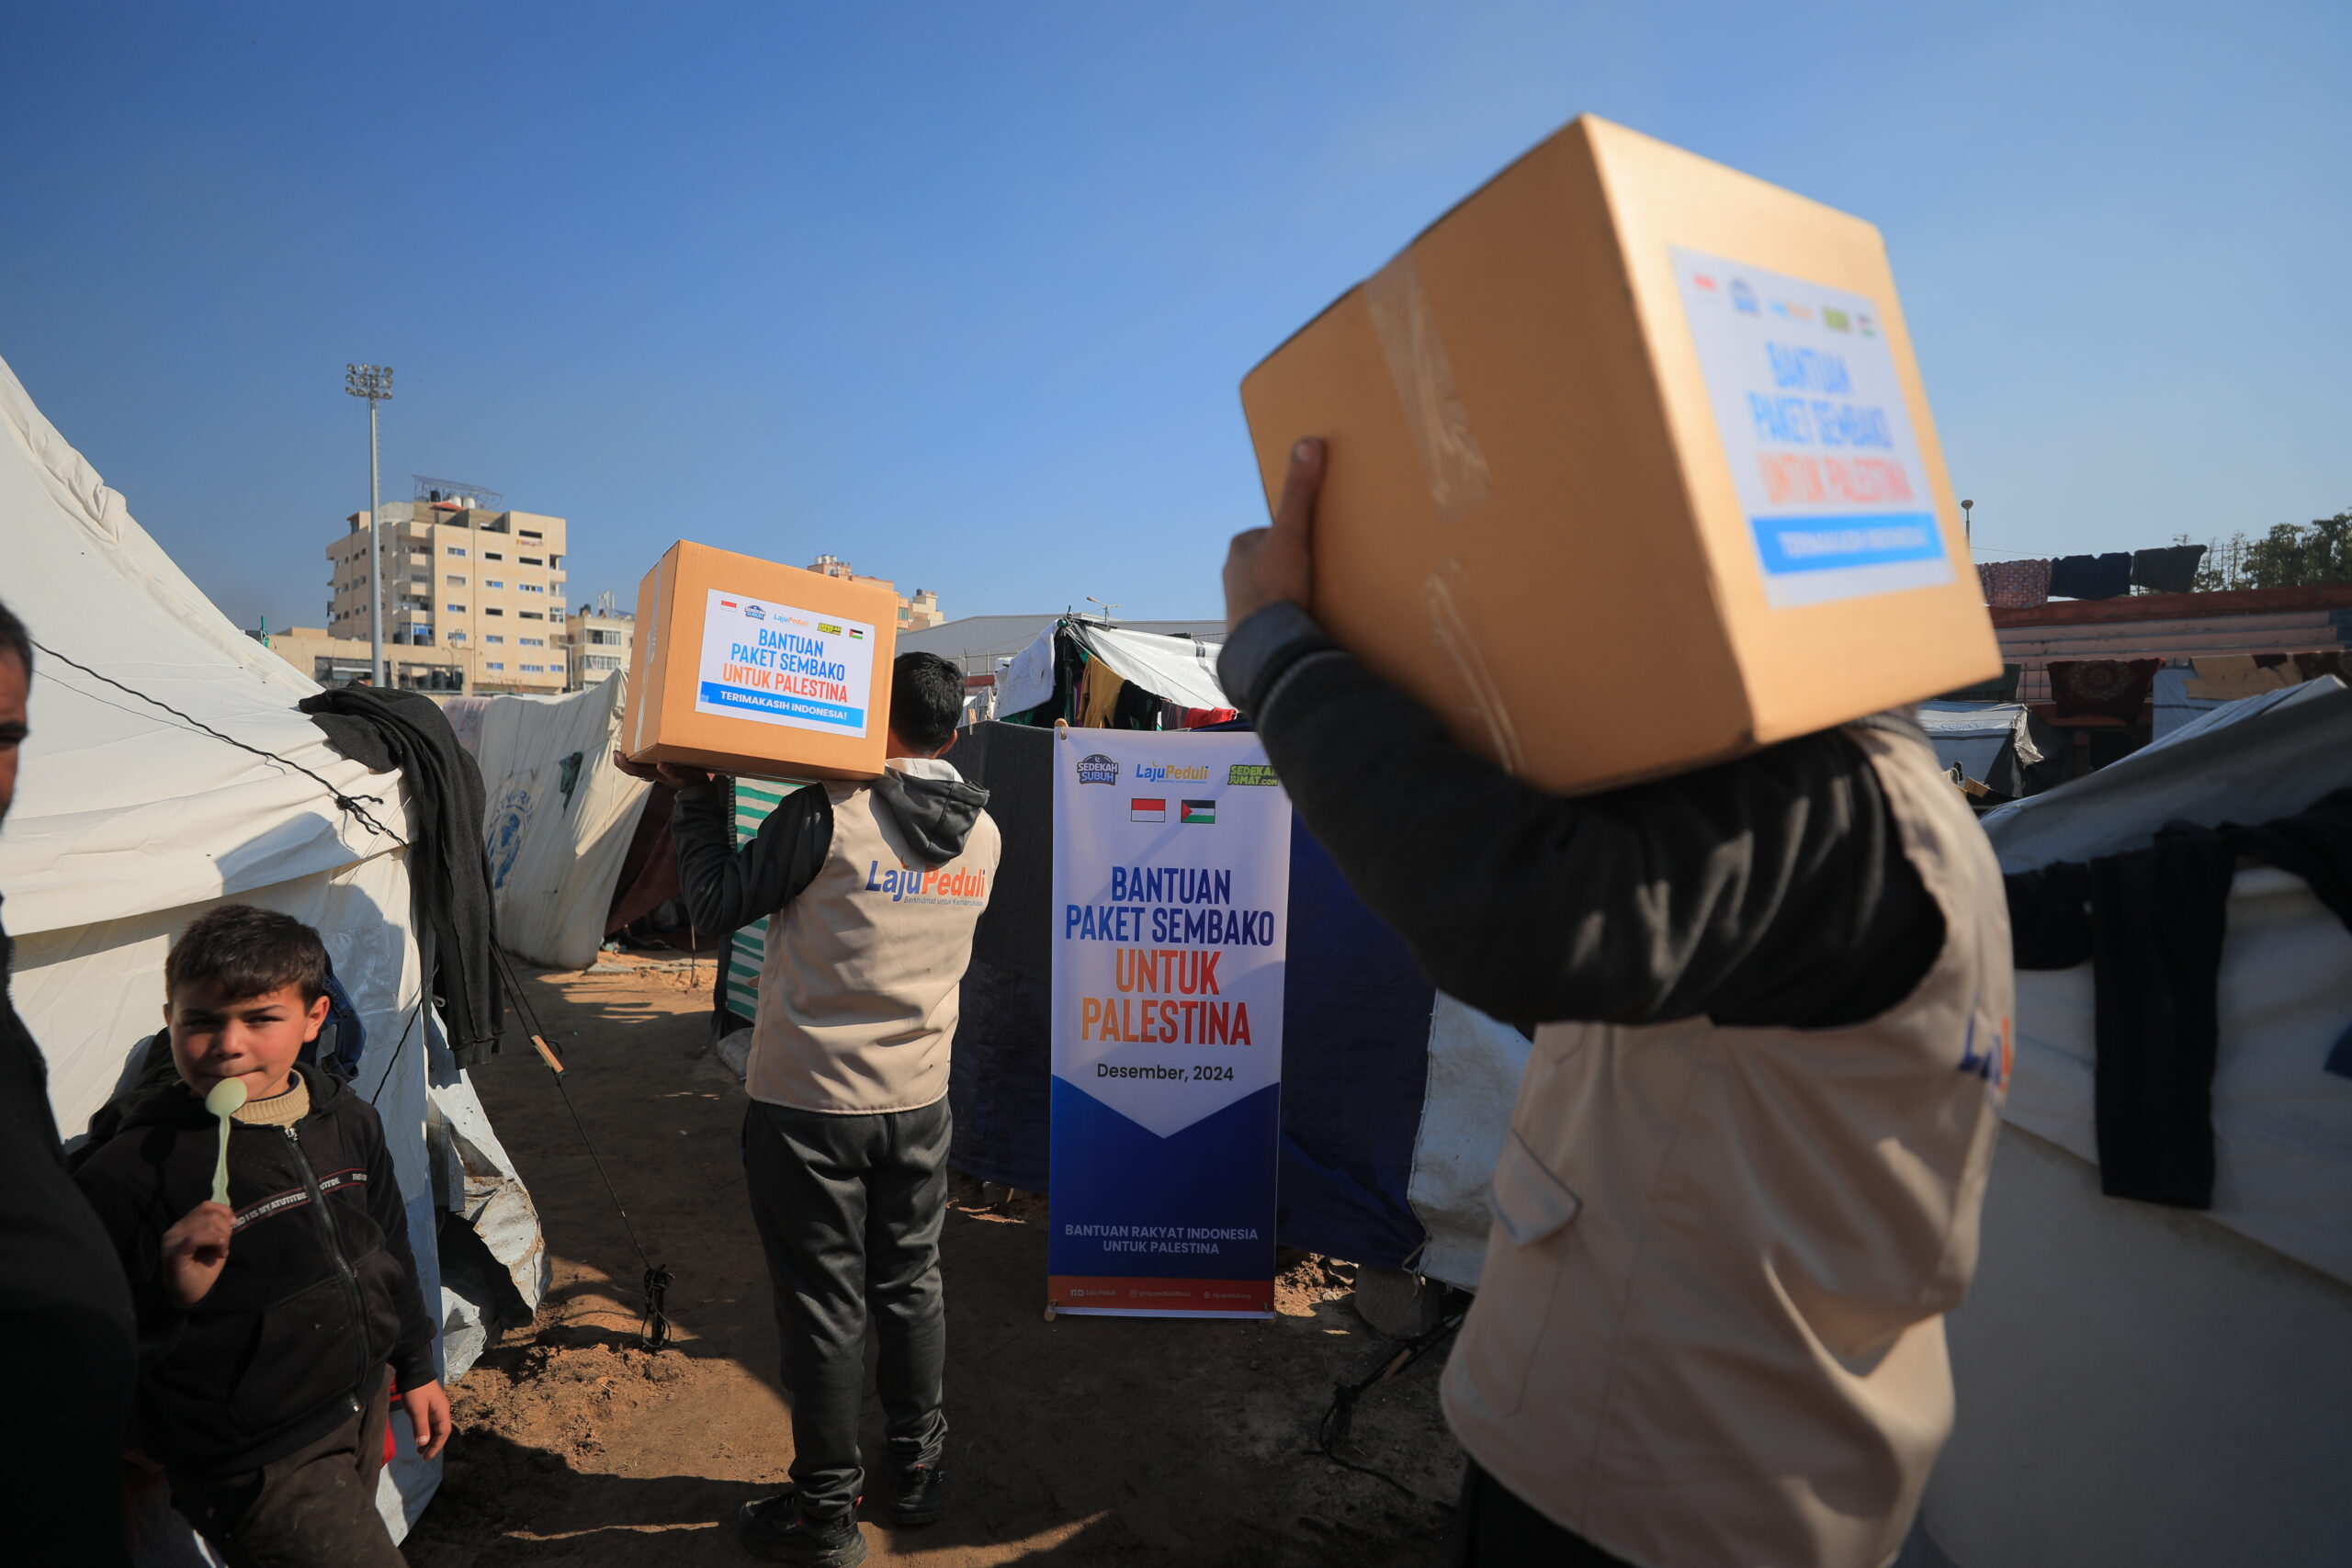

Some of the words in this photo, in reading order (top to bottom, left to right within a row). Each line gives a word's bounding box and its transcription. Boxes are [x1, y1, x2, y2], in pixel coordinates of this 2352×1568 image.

[759, 628, 823, 658] BANTUAN
[731, 643, 777, 668] PAKET
[780, 653, 845, 682] SEMBAKO
[723, 663, 772, 689] UNTUK
[775, 673, 847, 703] PALESTINA
[720, 691, 790, 710] TERIMAKASIH
[791, 704, 847, 720] INDONESIA!
[1078, 762, 1117, 773] SEDEKAH
[1081, 771, 1114, 782] SUBUH
[1136, 763, 1209, 782] LajuPeduli
[1230, 765, 1279, 776] SEDEKA
[865, 860, 986, 902] LajuPeduli
[1112, 866, 1230, 905] BANTUAN
[1066, 905, 1145, 942] PAKET
[1152, 908, 1274, 946] SEMBAKO
[1116, 948, 1221, 995] UNTUK
[1082, 998, 1251, 1045] PALESTINA
[1097, 1064, 1189, 1083] Desember,
[1193, 1066, 1234, 1081] 2024
[1066, 1224, 1128, 1237] BANTUAN
[1132, 1226, 1184, 1238] RAKYAT
[1187, 1228, 1258, 1240] INDONESIA
[1102, 1241, 1147, 1252] UNTUK
[1150, 1242, 1220, 1255] PALESTINA
